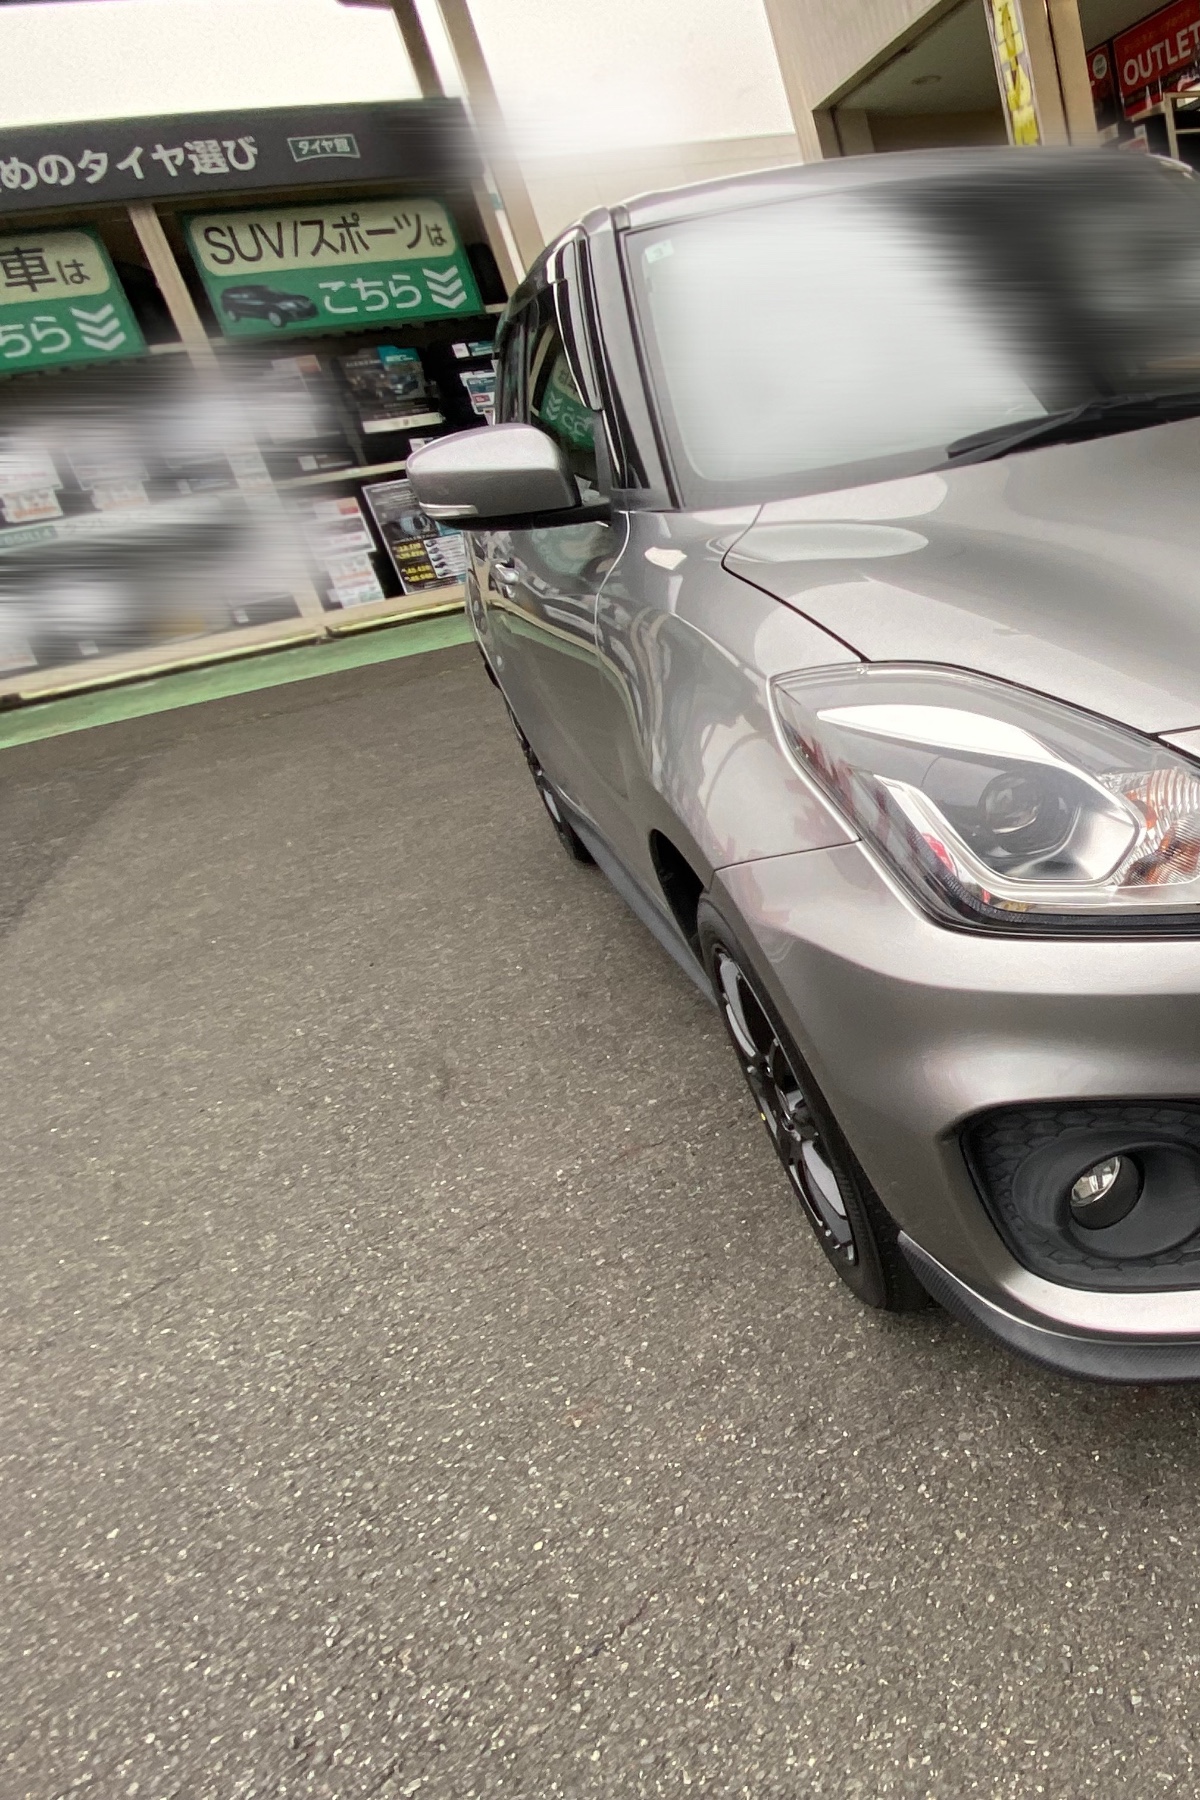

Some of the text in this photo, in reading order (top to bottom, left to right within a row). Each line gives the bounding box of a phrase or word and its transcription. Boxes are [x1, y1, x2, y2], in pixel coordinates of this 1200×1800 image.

[0, 136, 258, 190] めのタイヤ選び
[298, 138, 350, 155] タイヤ館
[204, 212, 447, 265] SUV/スポーツは
[0, 246, 91, 292] 車は
[317, 275, 423, 315] こちら
